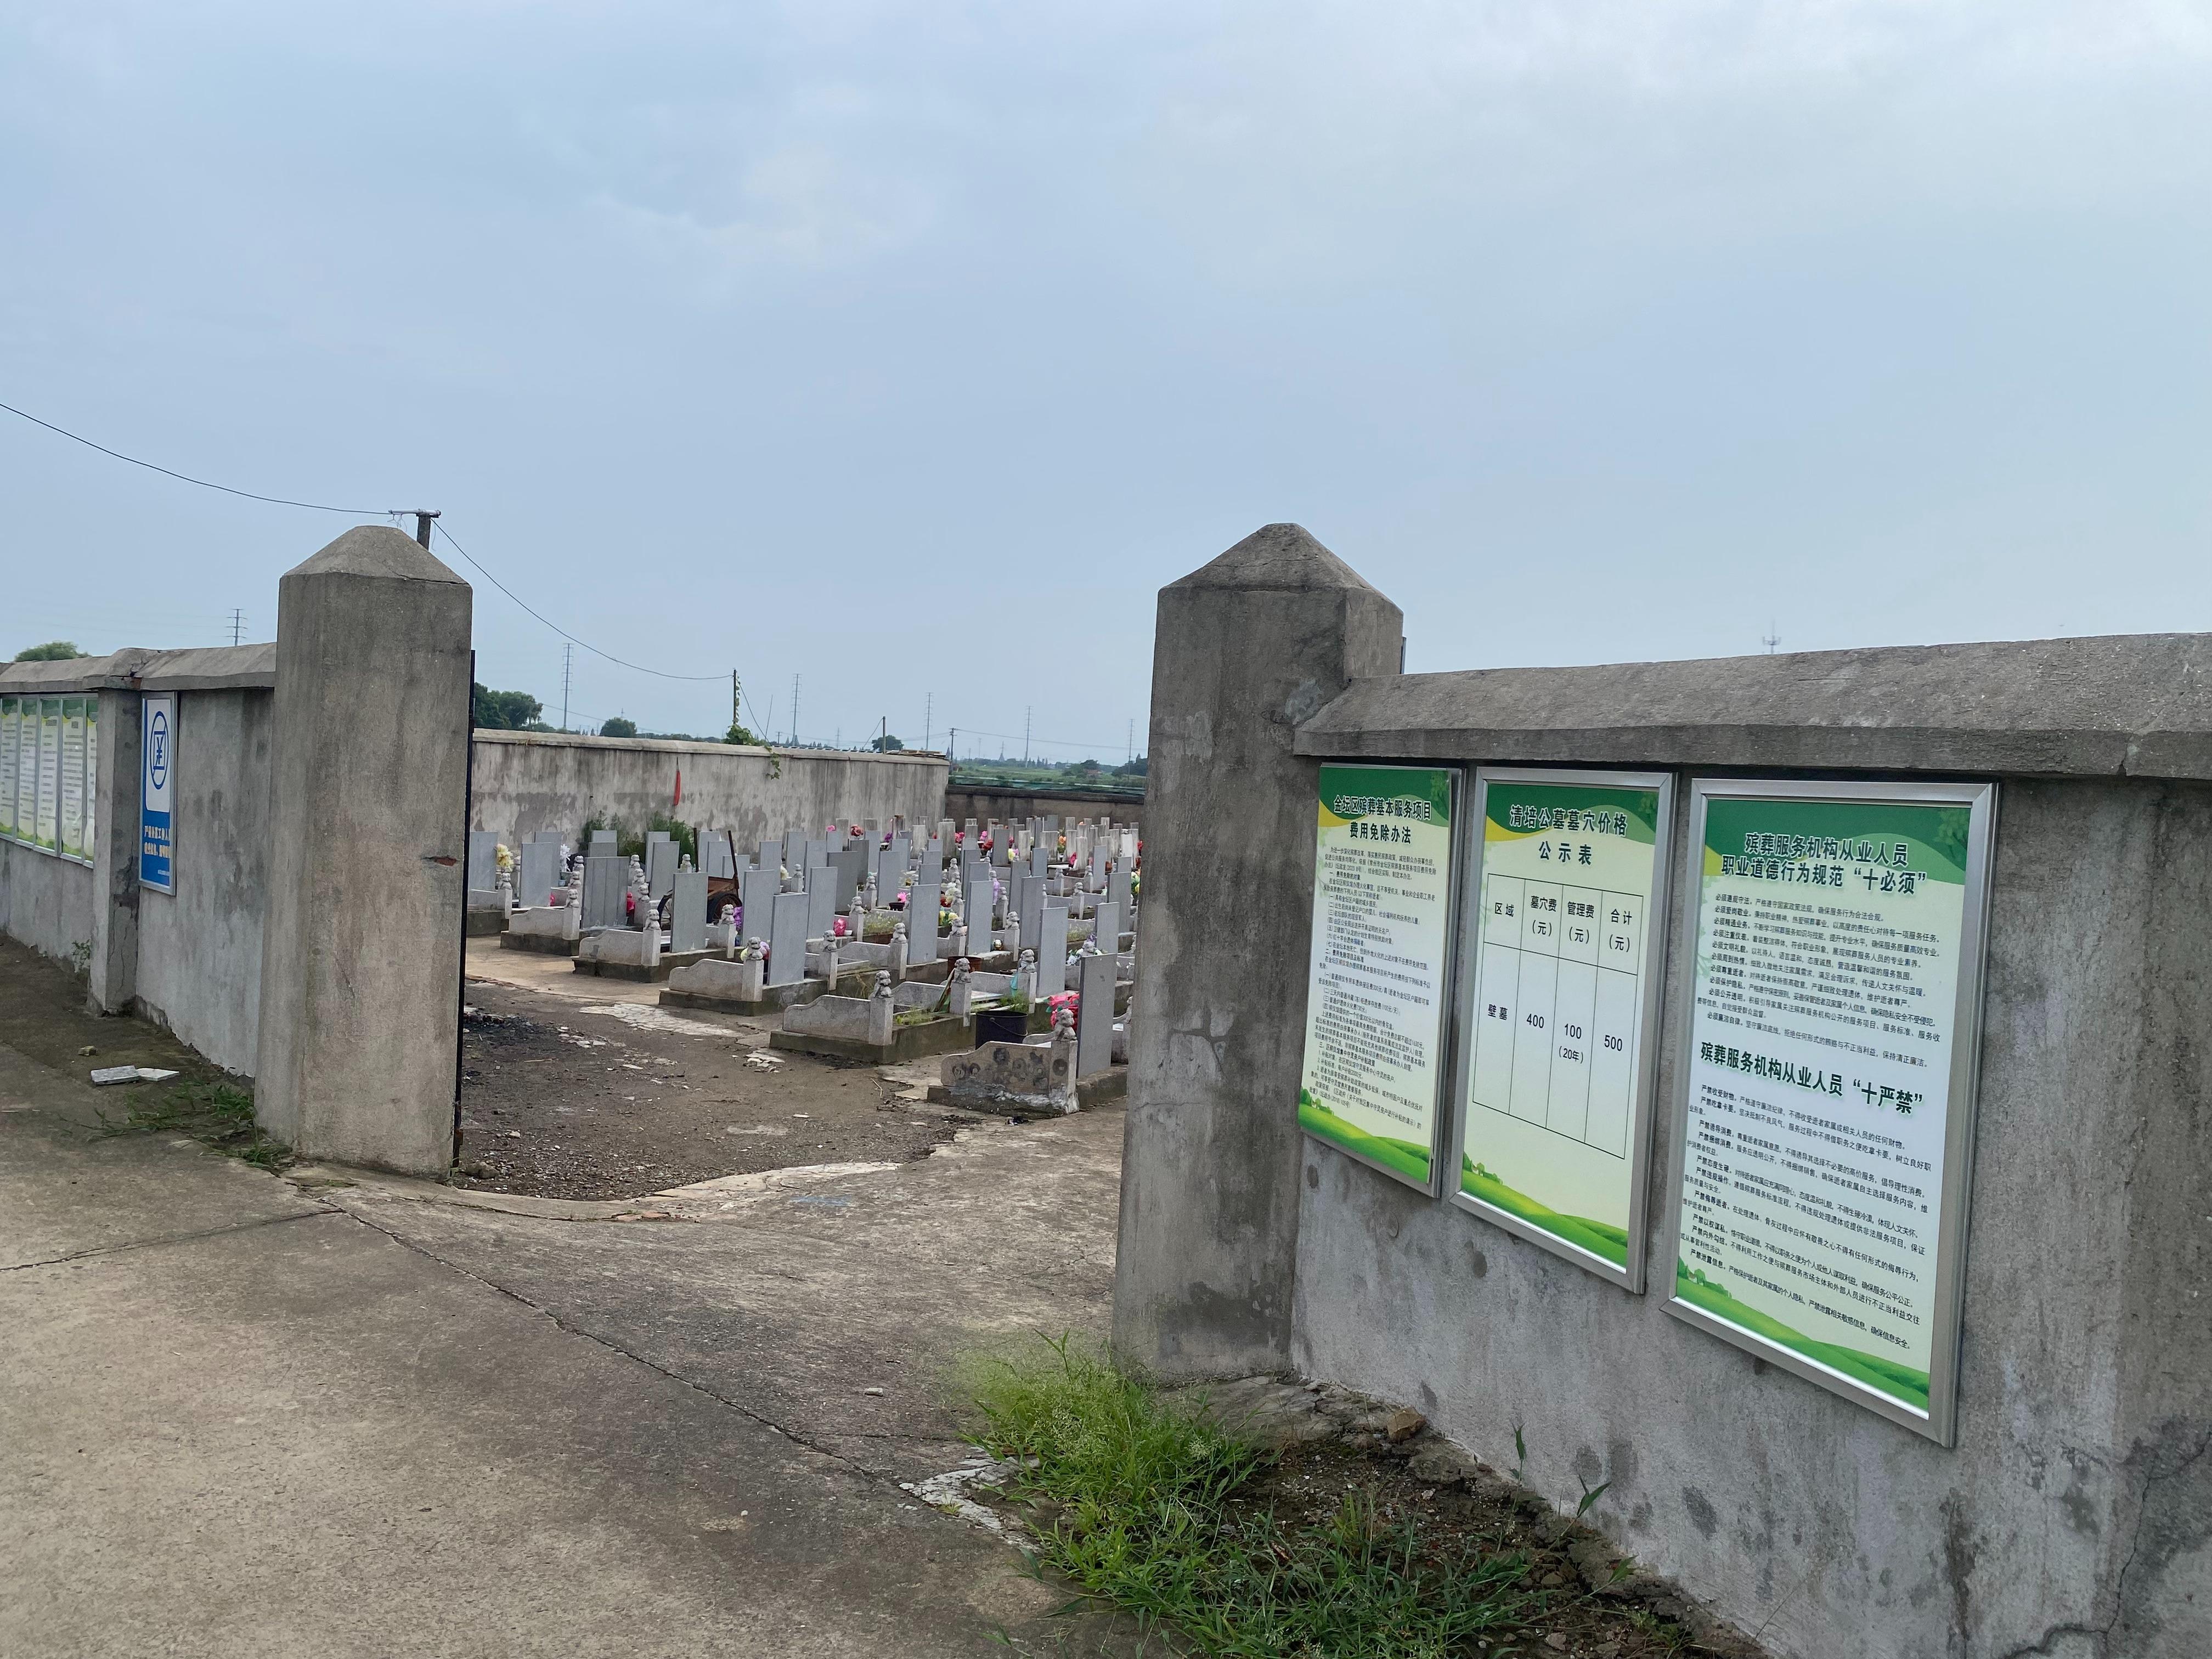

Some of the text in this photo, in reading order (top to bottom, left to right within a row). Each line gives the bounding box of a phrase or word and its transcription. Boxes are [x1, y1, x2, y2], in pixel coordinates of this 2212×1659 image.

[1333, 794, 1431, 820] 金坛区殡葬基本服务项目
[1509, 804, 1629, 837] 清培公墓墓穴价格
[1350, 821, 1410, 844] 费用免除办法
[1538, 840, 1593, 866] 公示表
[1745, 832, 1909, 867] 殡葬服务机构从业人员
[1720, 854, 1927, 895] 职业道德行为规范“十必须”
[1494, 901, 1515, 918] 区域
[1530, 894, 1556, 913] 墓穴费
[1567, 901, 1594, 919] 管理费
[1610, 908, 1632, 926] 合计
[1532, 920, 1553, 938] （元）
[1568, 927, 1590, 945] （元）
[1609, 934, 1630, 953] （元）
[1487, 1003, 1508, 1022] 壁墓
[1526, 1012, 1544, 1030] 400
[1564, 1022, 1582, 1040] 100
[1604, 1034, 1623, 1053] 500
[1558, 1045, 1584, 1065] （20年）
[1700, 1040, 1923, 1118] 殡葬服务机构从业人员“十严禁”
